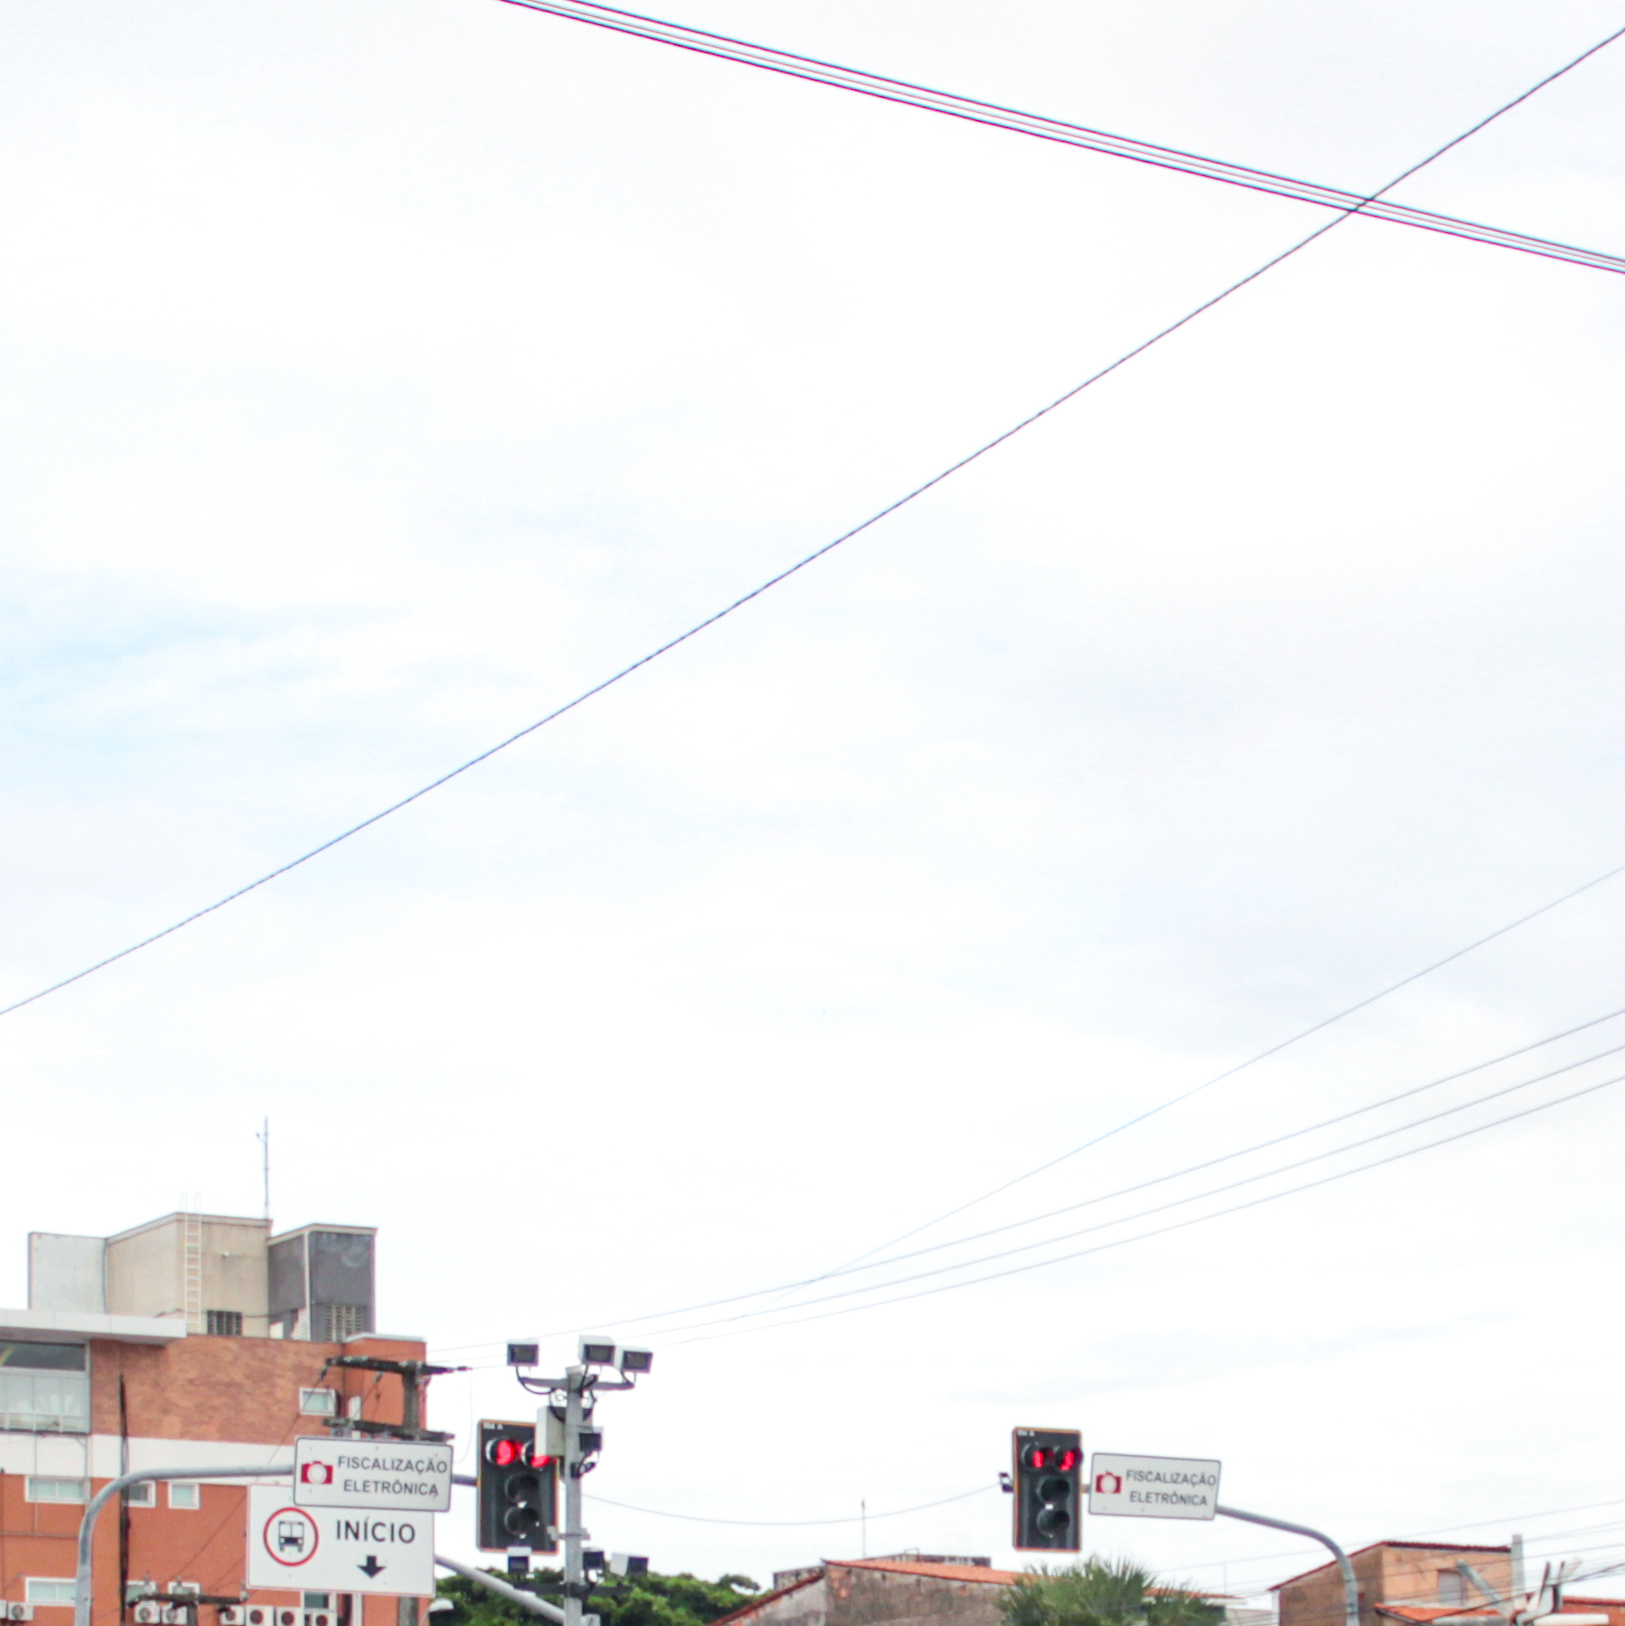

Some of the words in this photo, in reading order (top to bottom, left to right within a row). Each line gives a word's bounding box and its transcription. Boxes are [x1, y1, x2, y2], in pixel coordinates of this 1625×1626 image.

[337, 1455, 448, 1475] FISCALIZAÇÃO
[343, 1478, 439, 1497] ELETRÔNICA
[1125, 1469, 1217, 1488] FISCALIZAÇÃO
[1129, 1490, 1208, 1506] ELETRÔNICA
[336, 1516, 416, 1544] INÍCIO
